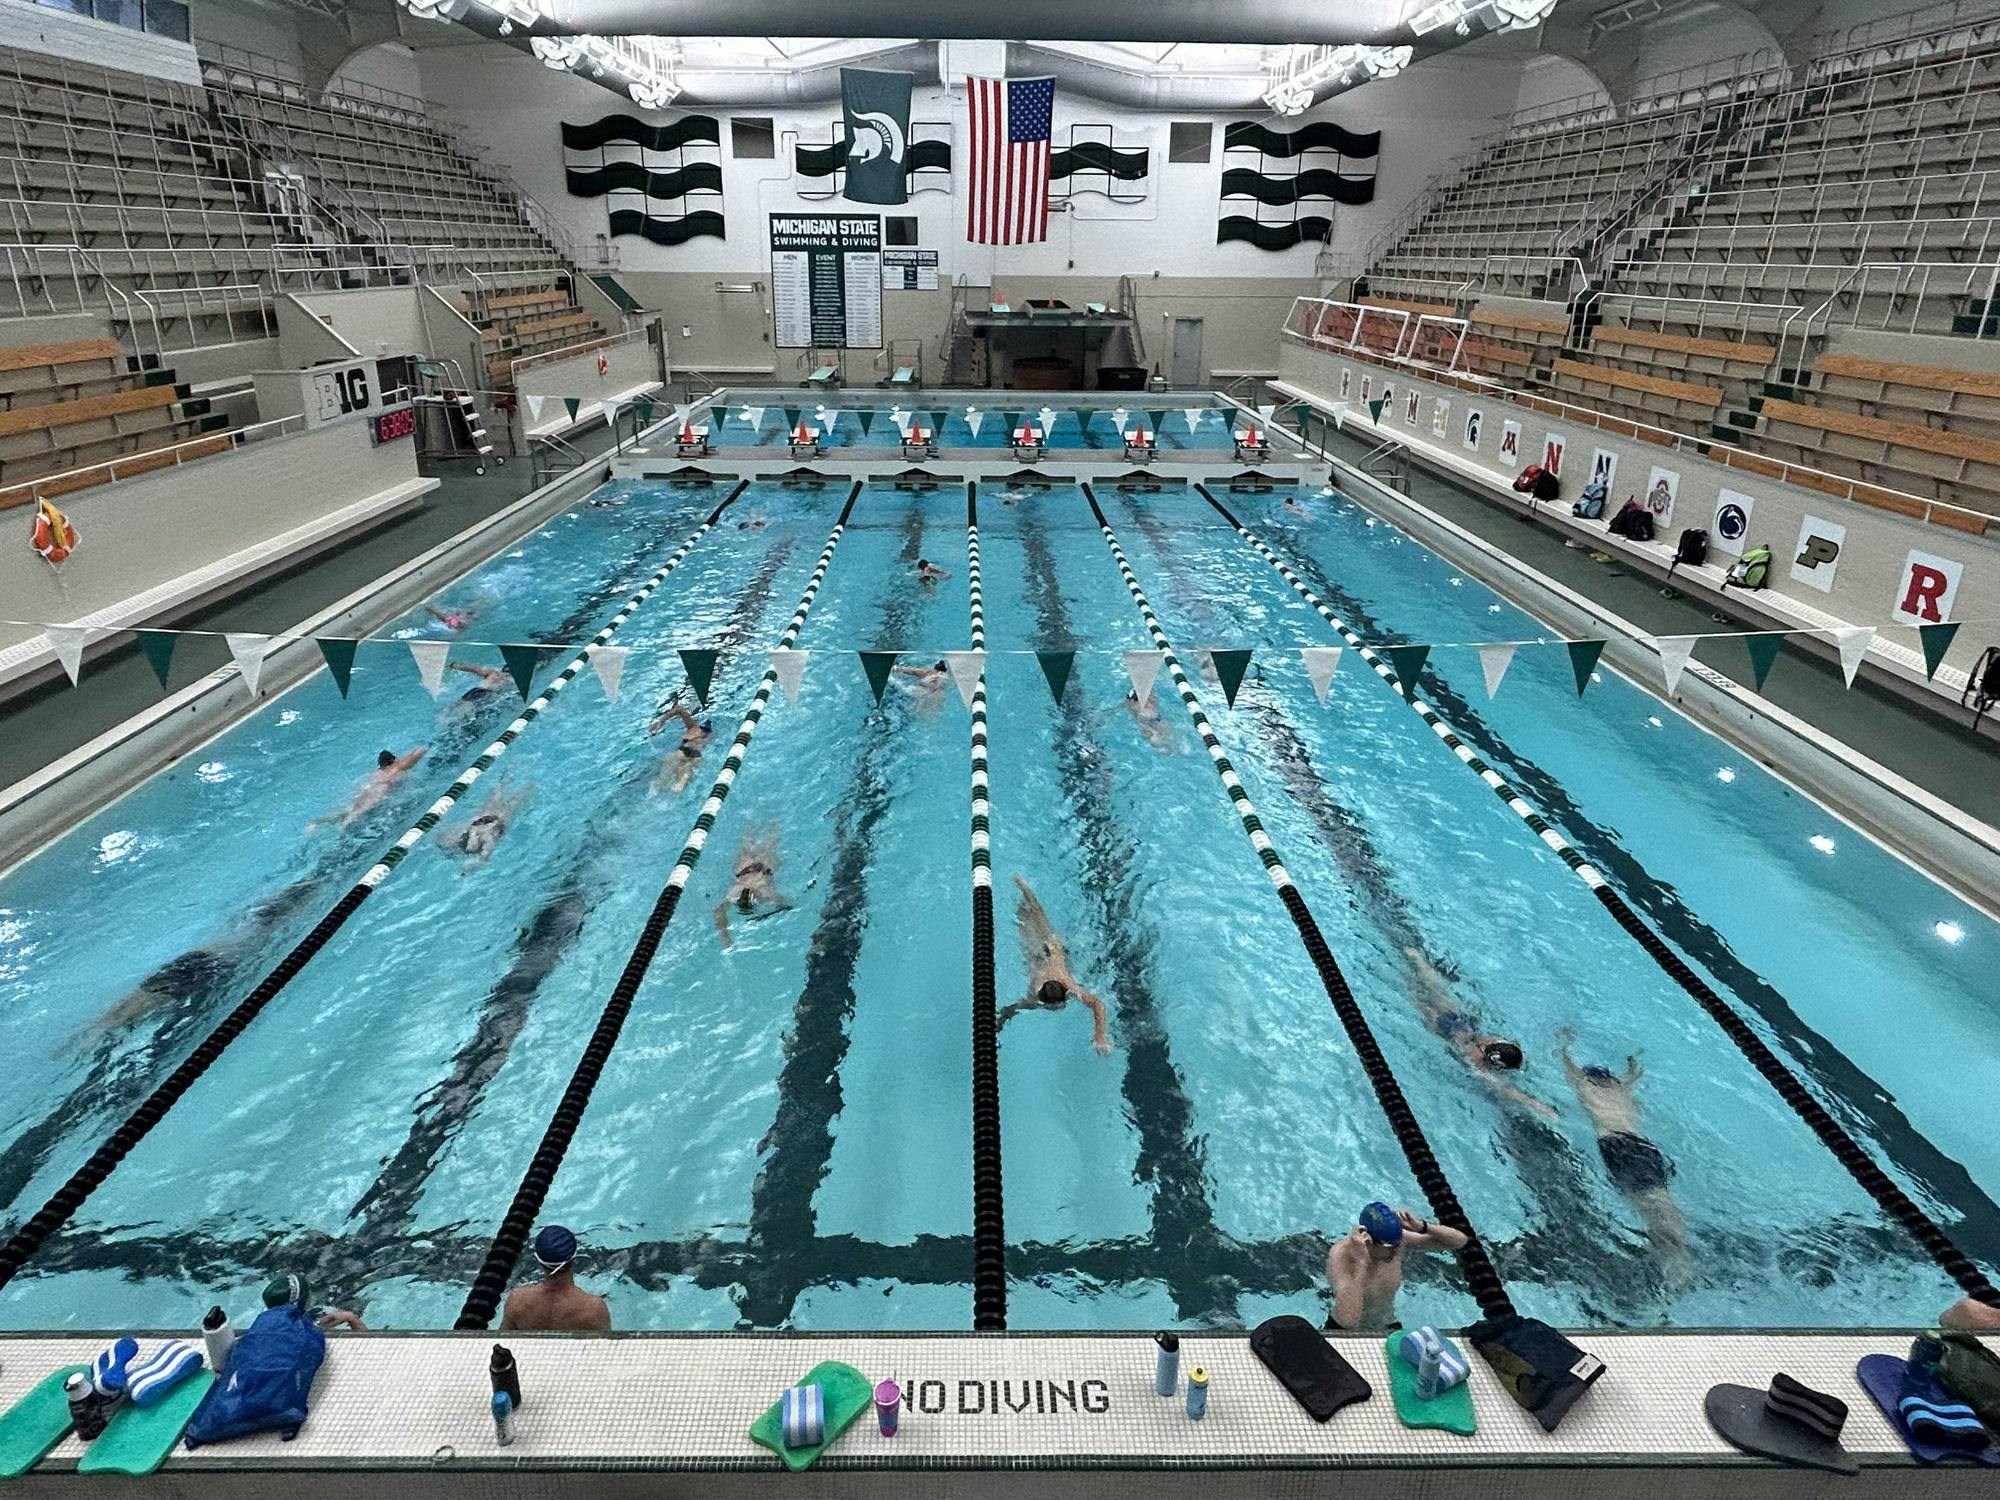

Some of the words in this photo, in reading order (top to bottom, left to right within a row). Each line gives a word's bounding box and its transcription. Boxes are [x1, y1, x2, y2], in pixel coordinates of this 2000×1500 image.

[772, 219, 837, 235] MICHIGAN
[839, 219, 878, 235] STATE
[773, 237, 828, 246] SWIMMING
[831, 237, 839, 246] &
[842, 237, 878, 246] DIVING
[1545, 441, 1562, 475] N
[1795, 534, 1840, 569] P
[1900, 562, 1948, 622] R
[958, 1380, 1110, 1414] DIVING
